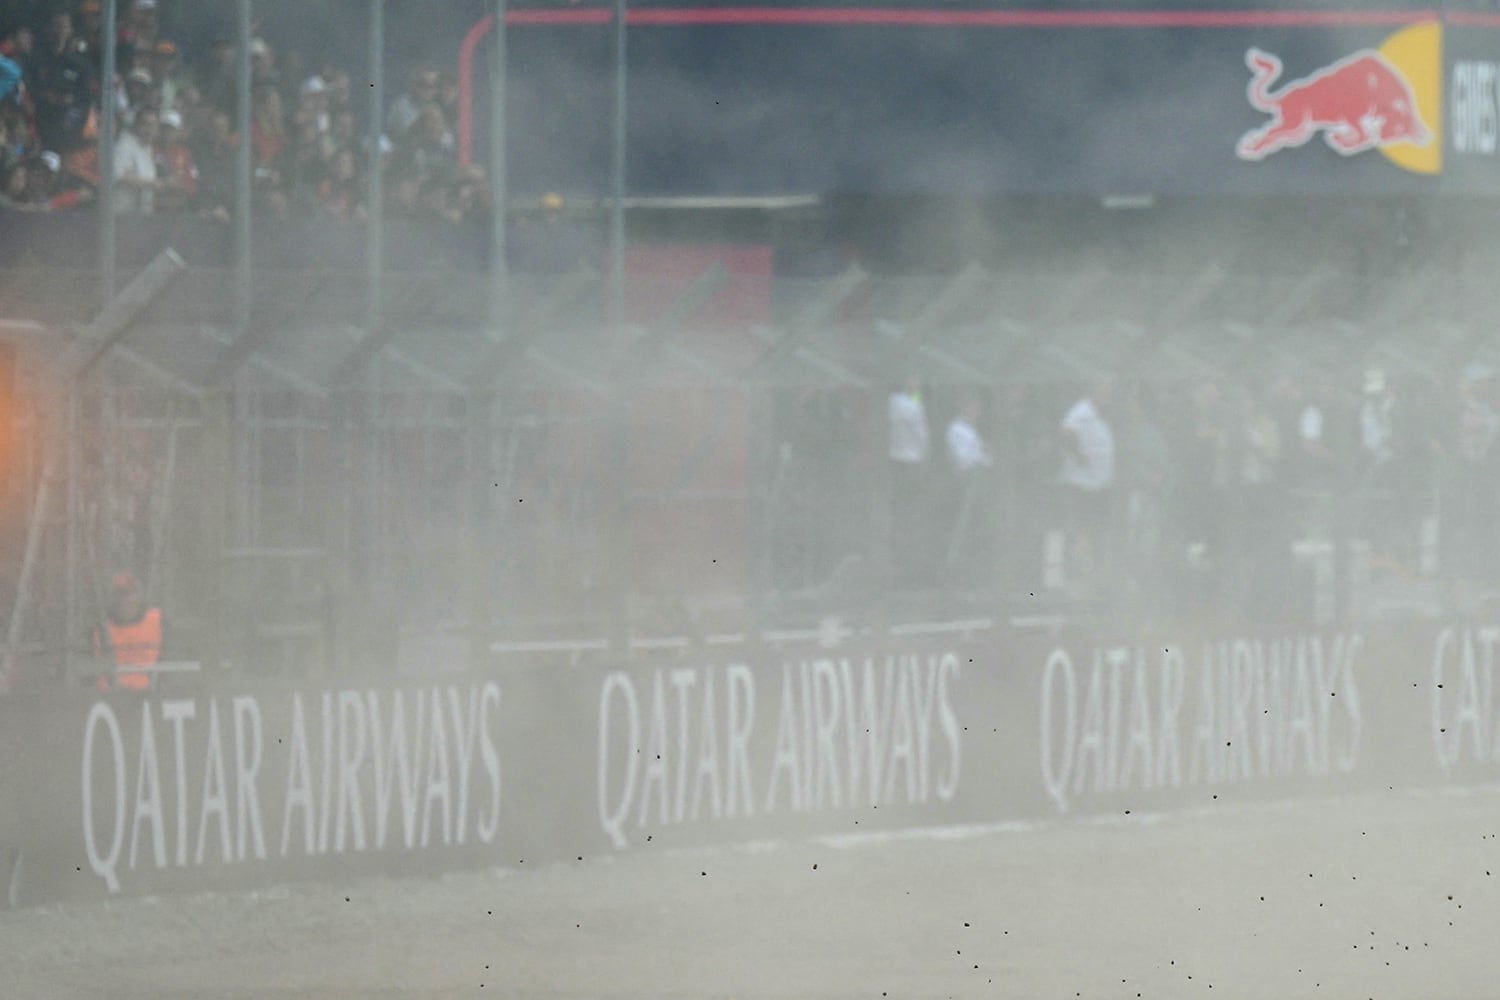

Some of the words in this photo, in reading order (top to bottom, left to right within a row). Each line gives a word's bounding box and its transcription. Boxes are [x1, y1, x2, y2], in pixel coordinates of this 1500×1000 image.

[82, 695, 267, 893] QATAR
[279, 682, 499, 856] AIRWAYS
[599, 662, 755, 847] QATAR
[765, 652, 960, 812] AIRWAYS
[1040, 642, 1187, 812] QATAR
[1190, 633, 1361, 786] AIRWAYS
